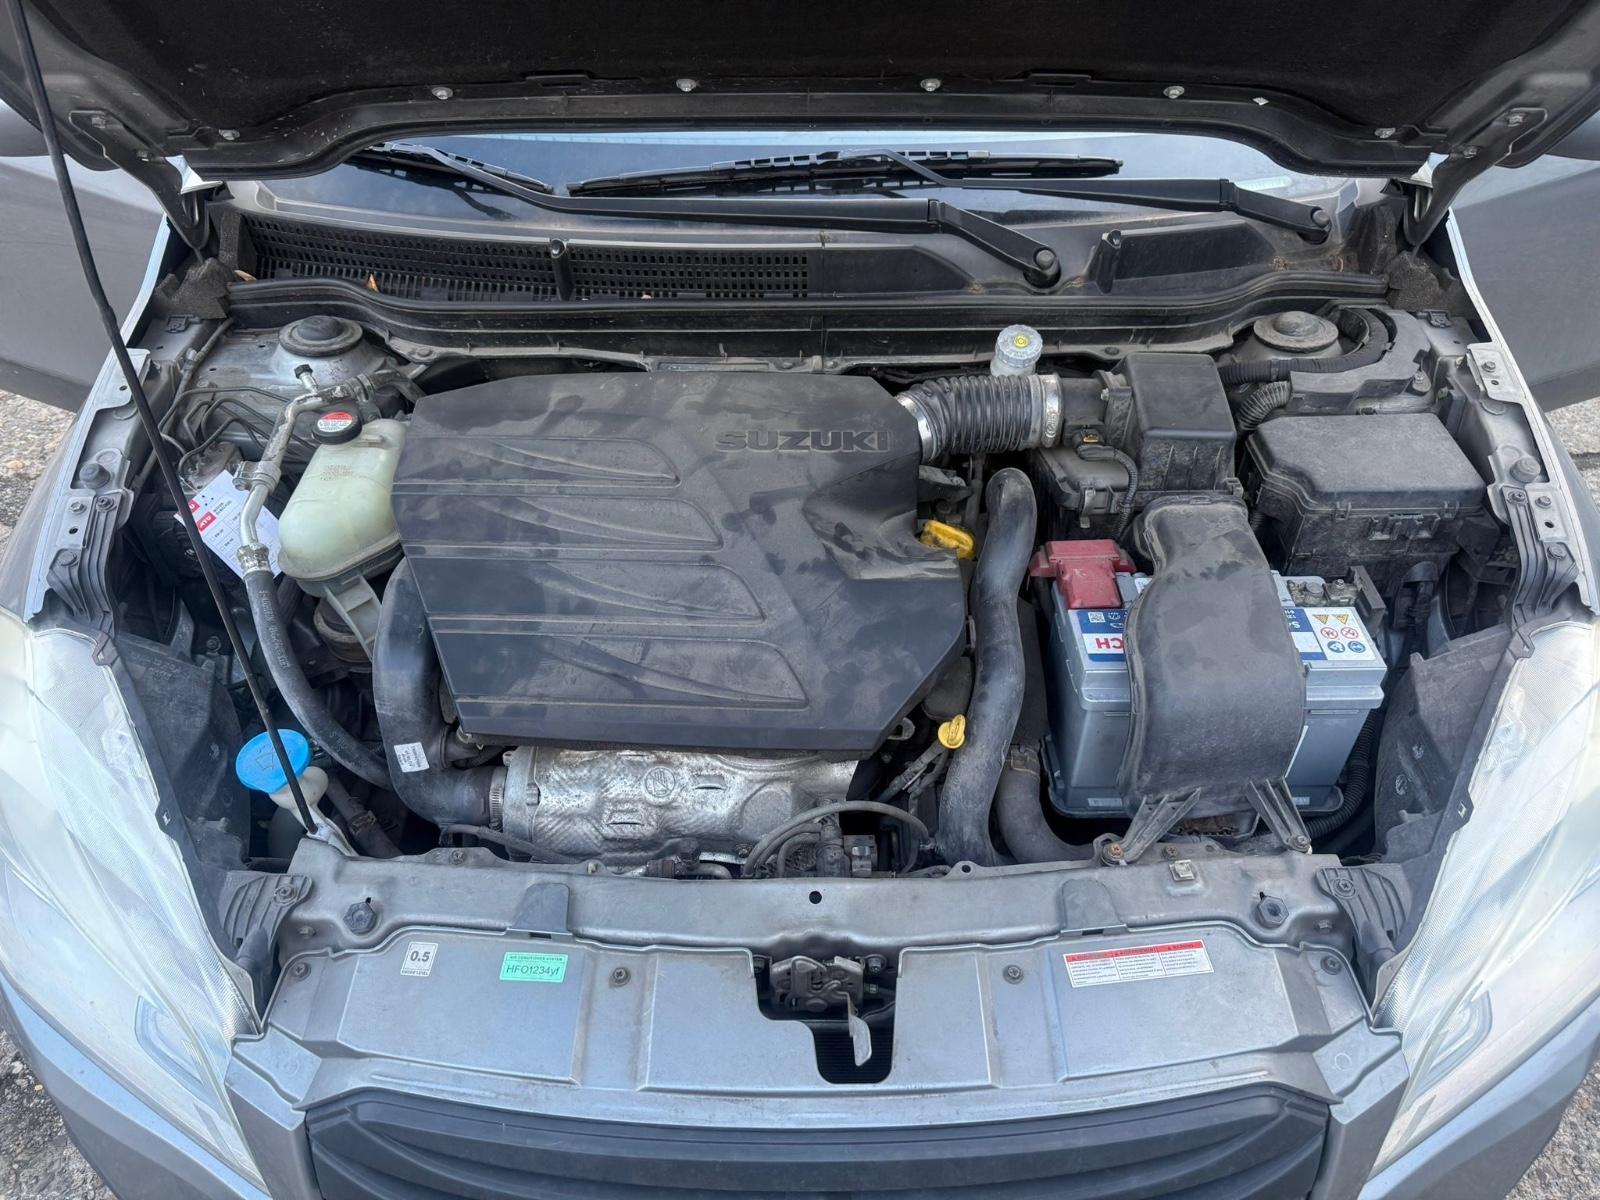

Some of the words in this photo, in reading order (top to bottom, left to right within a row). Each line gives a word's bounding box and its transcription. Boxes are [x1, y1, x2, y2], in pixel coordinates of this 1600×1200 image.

[715, 430, 890, 452] SUZUKI
[1095, 637, 1125, 650] CH
[410, 950, 431, 962] 0.5
[506, 964, 561, 977] HFO1234yf
